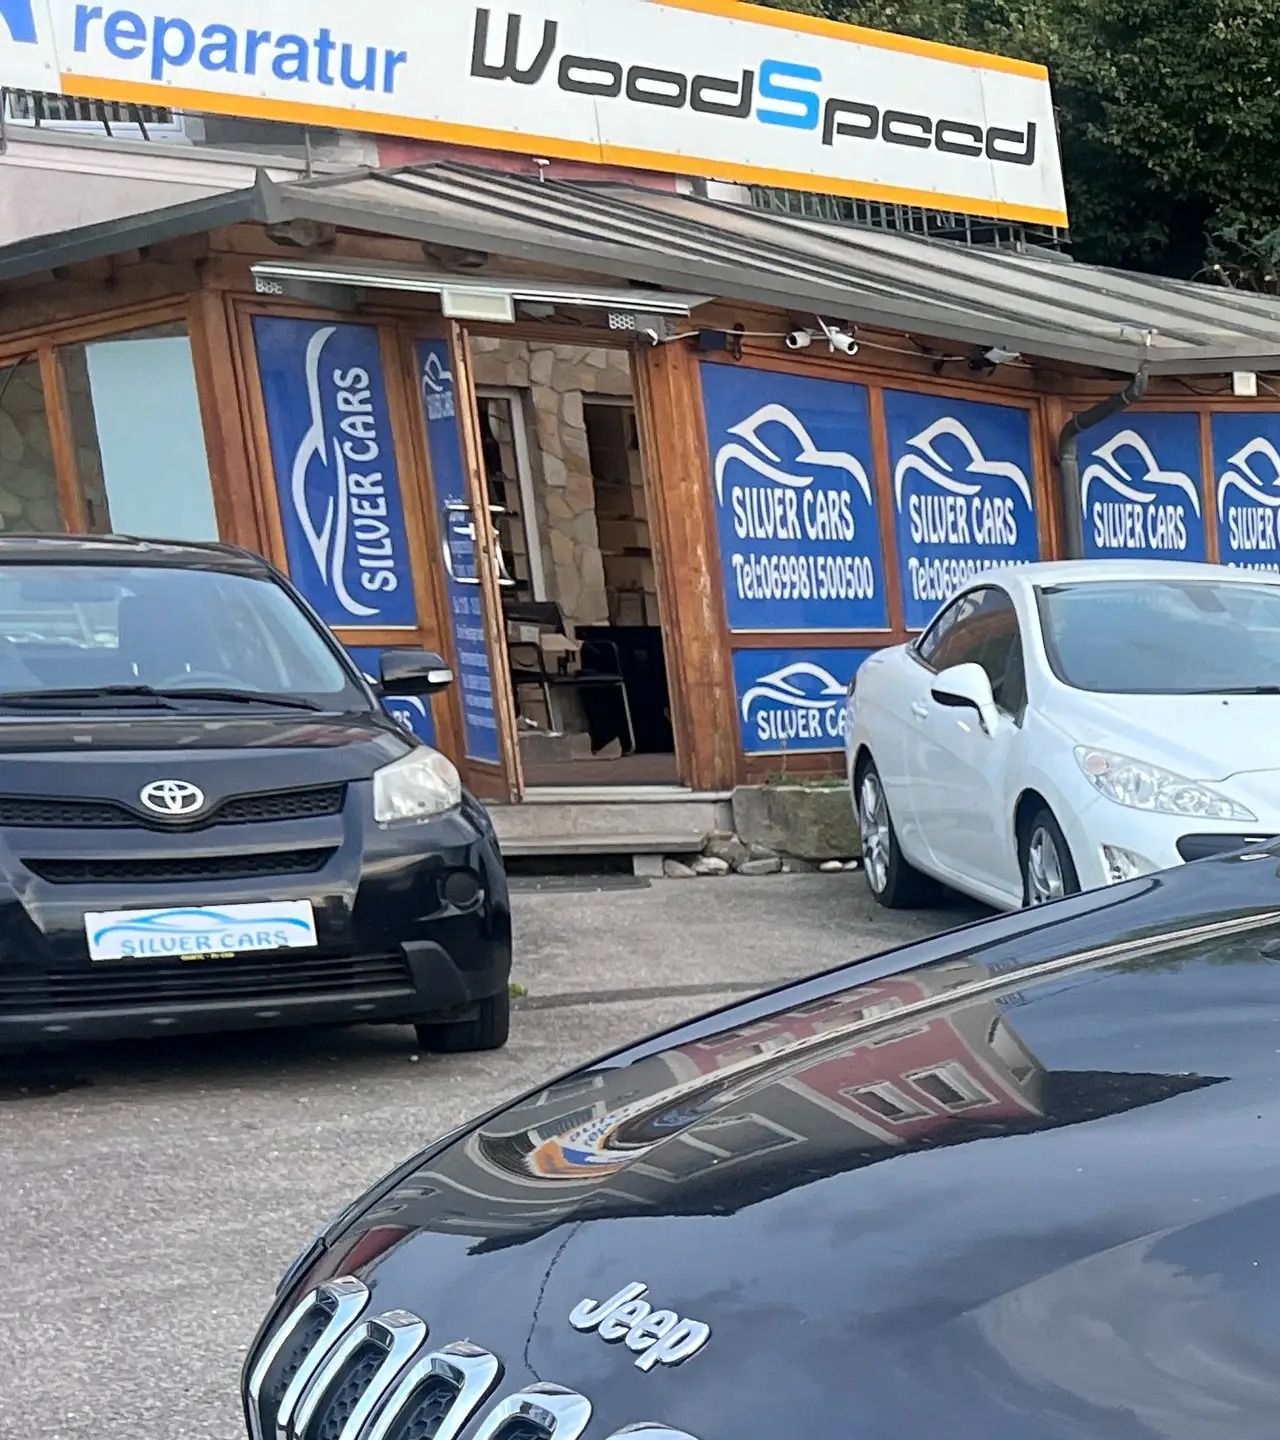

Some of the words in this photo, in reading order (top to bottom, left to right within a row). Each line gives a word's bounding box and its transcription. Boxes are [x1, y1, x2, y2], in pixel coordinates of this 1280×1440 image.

[73, 3, 408, 94] reparatur
[332, 366, 380, 462] CARS
[347, 471, 398, 592] SILVER
[731, 486, 802, 541] SILVER
[803, 488, 855, 542] CARS
[908, 493, 971, 545] SILVER
[971, 496, 1018, 546] CARS
[1092, 501, 1146, 549] SILVER
[1149, 504, 1187, 551] CARS
[1228, 506, 1276, 551] SILVER
[731, 553, 874, 601] Tel:069981500500
[756, 709, 824, 740] SILVER
[120, 934, 212, 956] SILVER
[220, 930, 289, 950] CARS
[568, 1281, 711, 1373] Jeep
